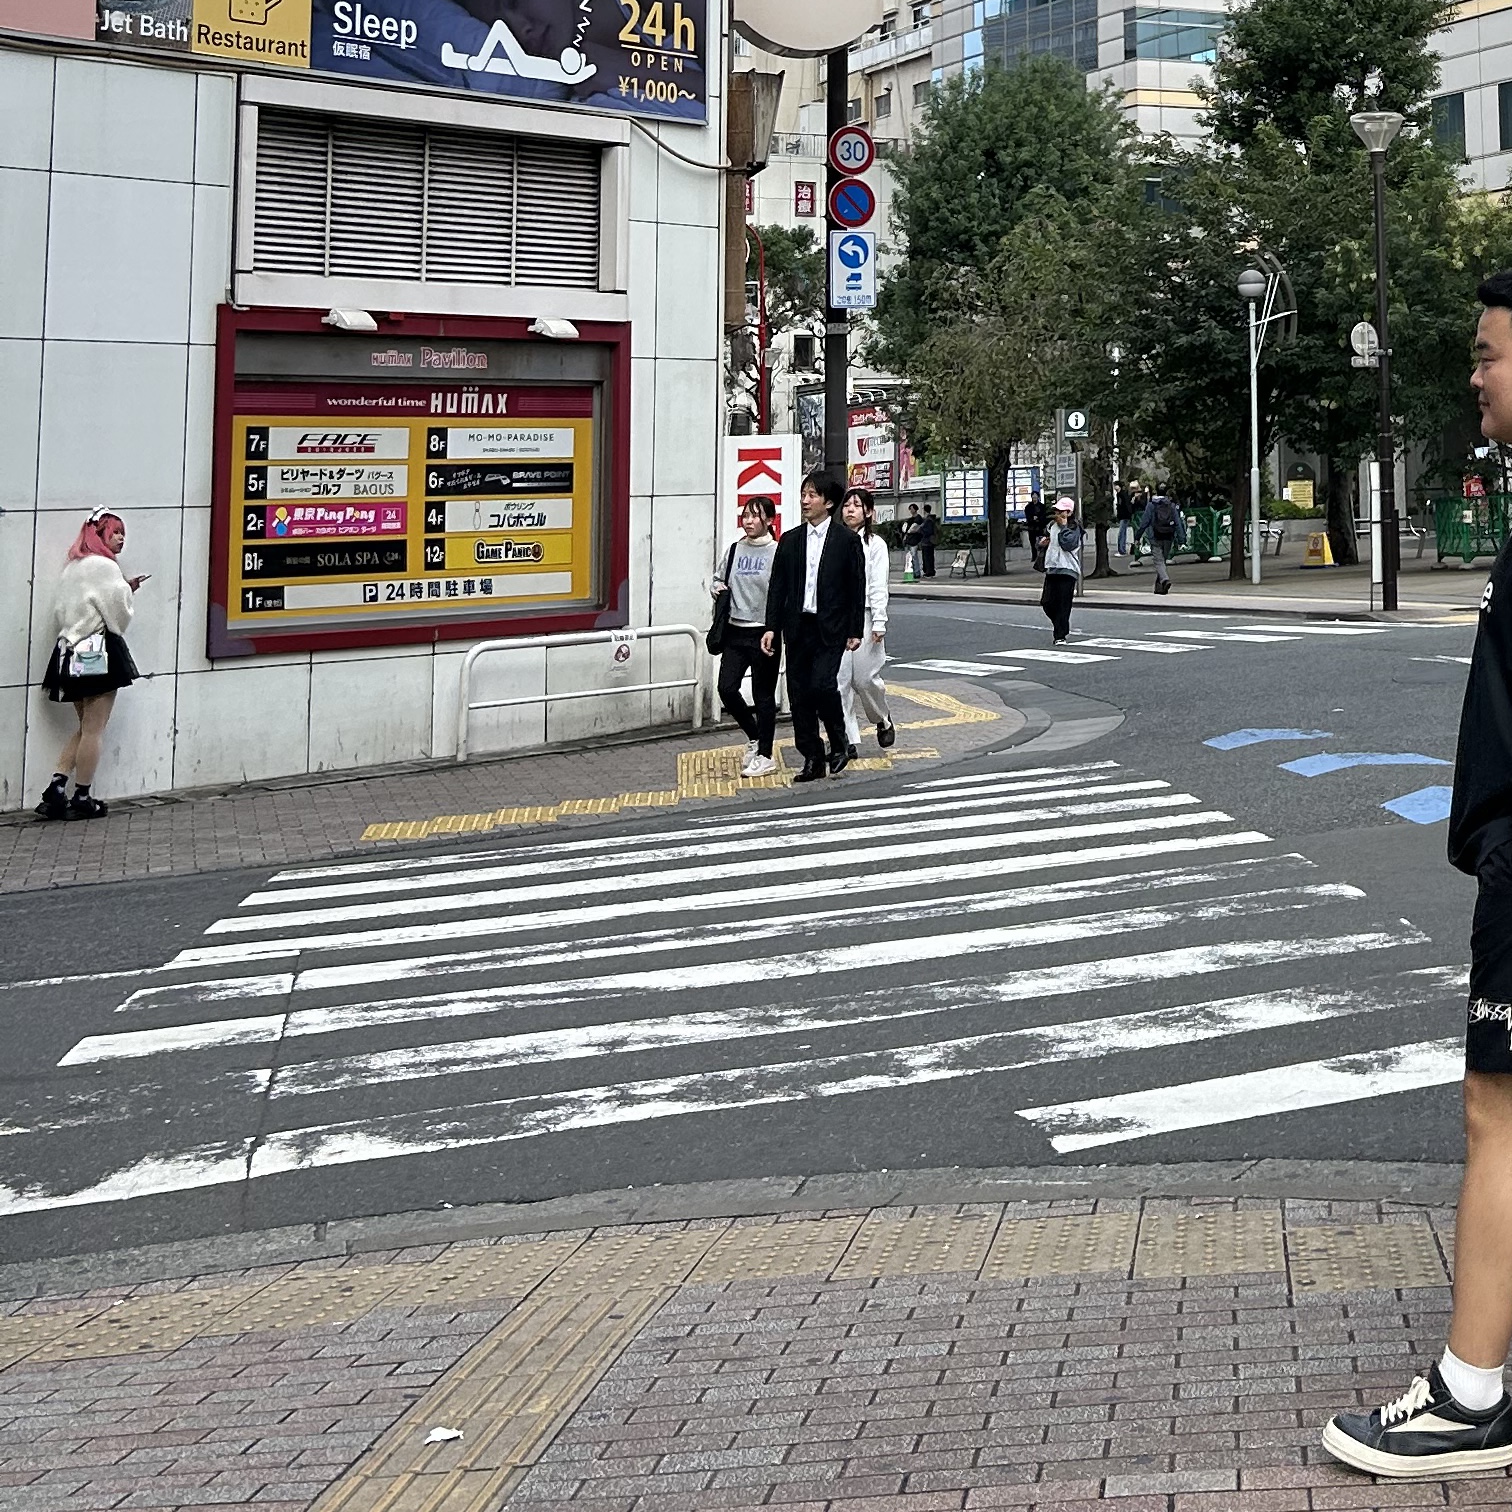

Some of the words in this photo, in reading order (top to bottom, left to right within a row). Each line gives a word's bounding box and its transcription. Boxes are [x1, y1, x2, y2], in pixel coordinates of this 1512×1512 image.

[100, 9, 133, 35] Jet
[139, 15, 188, 43] Bath
[332, 0, 418, 50] Sleep
[197, 23, 308, 59] Restaurant
[630, 51, 684, 73] OPEN
[839, 140, 866, 162] 30
[420, 347, 488, 369] Pavilion
[326, 396, 396, 407] wonderful
[397, 396, 427, 408] time
[249, 434, 268, 453] 7F
[297, 433, 383, 447] FACE
[429, 434, 446, 452] 8F
[247, 473, 266, 493] 5F
[311, 482, 342, 496] ゴルフ
[428, 471, 445, 489] 6F
[503, 501, 536, 511] ボウリング
[246, 513, 265, 532] 2F
[427, 508, 444, 526] 4F
[316, 553, 352, 567] SOLA
[354, 551, 380, 566] SPA
[385, 578, 494, 601] 24時間駐車場
[245, 590, 264, 609] 1F
